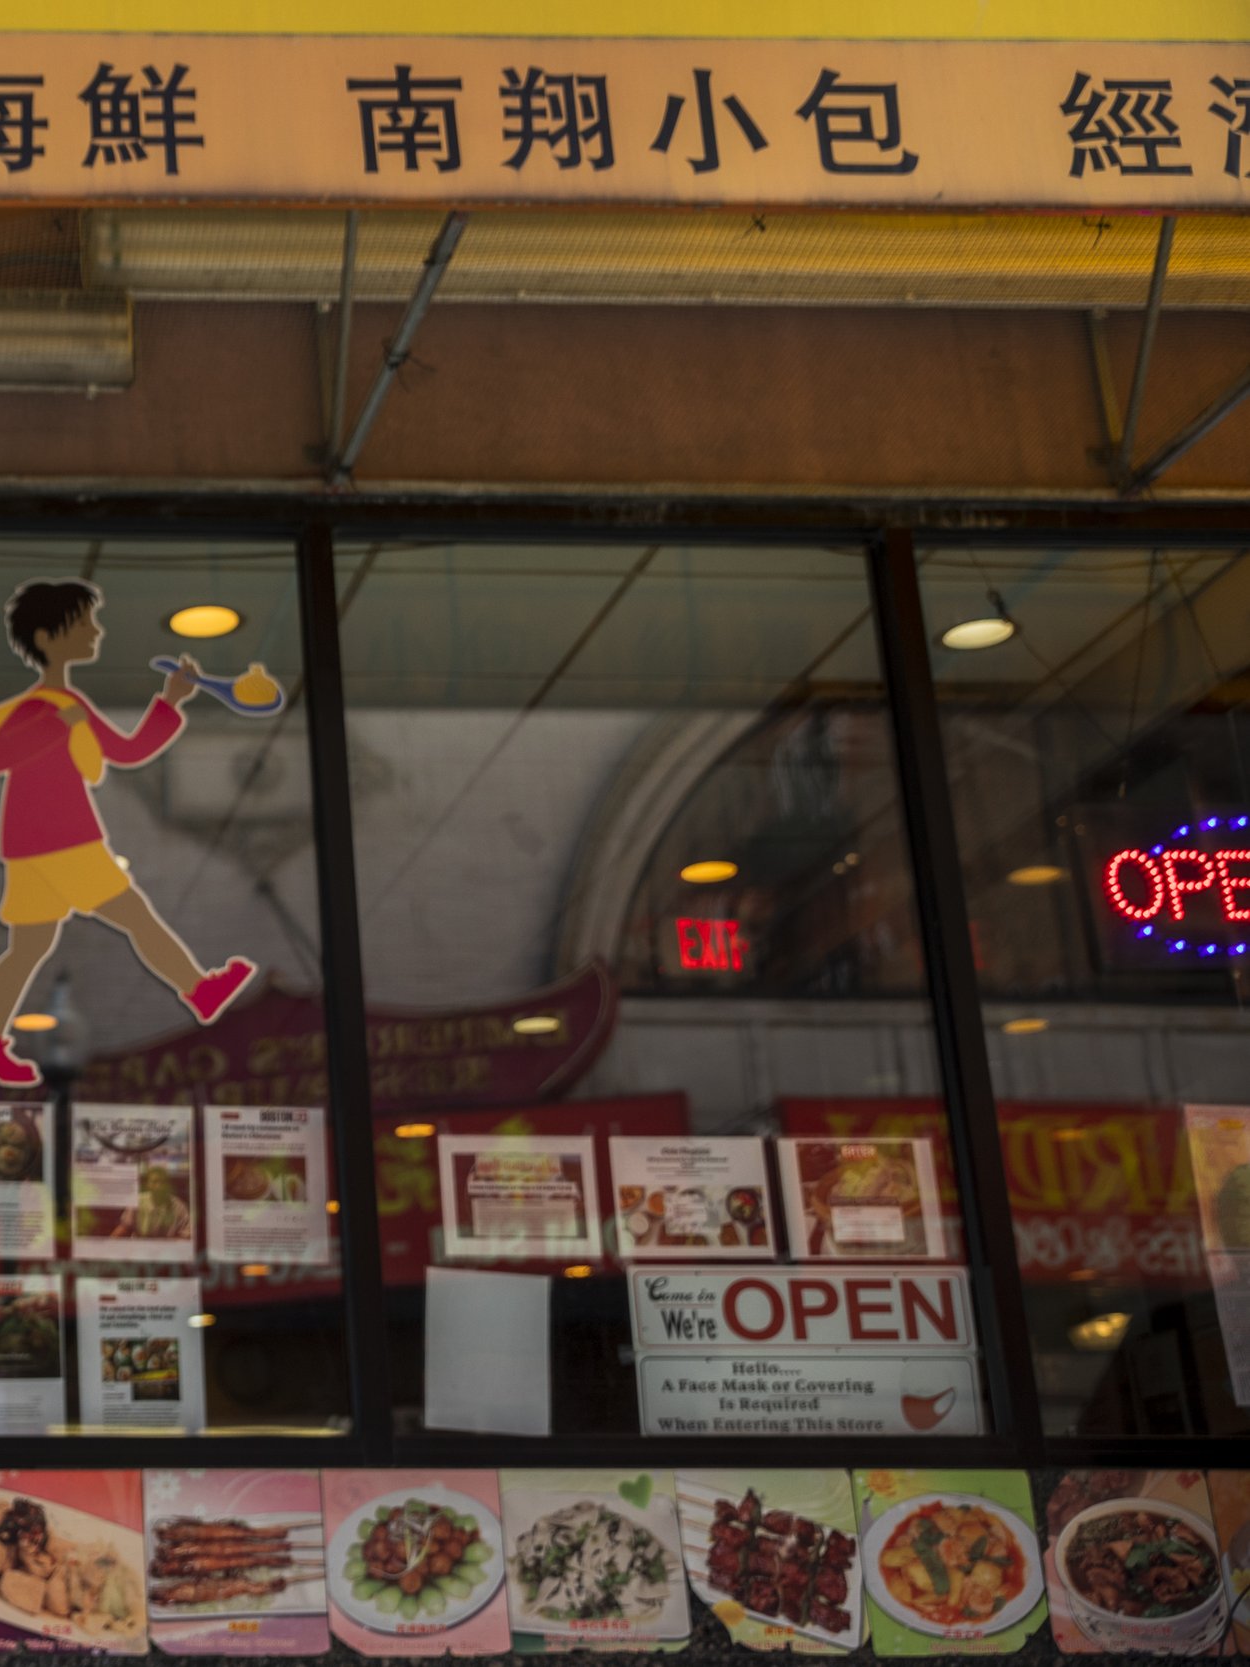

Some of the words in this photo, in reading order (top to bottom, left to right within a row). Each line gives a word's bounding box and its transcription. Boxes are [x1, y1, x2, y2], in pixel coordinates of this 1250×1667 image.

[347, 64, 919, 175] 南翔小包
[676, 917, 741, 971] EXIT
[645, 1276, 693, 1302] Come
[697, 1287, 717, 1301] in
[661, 1309, 717, 1339] We're
[722, 1277, 959, 1342] OPEN
[661, 1380, 674, 1392] A
[678, 1380, 717, 1393] Face
[721, 1379, 768, 1393] Mask
[772, 1382, 791, 1393] or
[795, 1378, 876, 1395] Covering
[719, 1397, 735, 1411] Is
[739, 1396, 820, 1414] Required
[657, 1418, 709, 1432] When
[713, 1417, 791, 1434] Entering
[796, 1416, 833, 1432] This
[836, 1417, 884, 1432] Store
